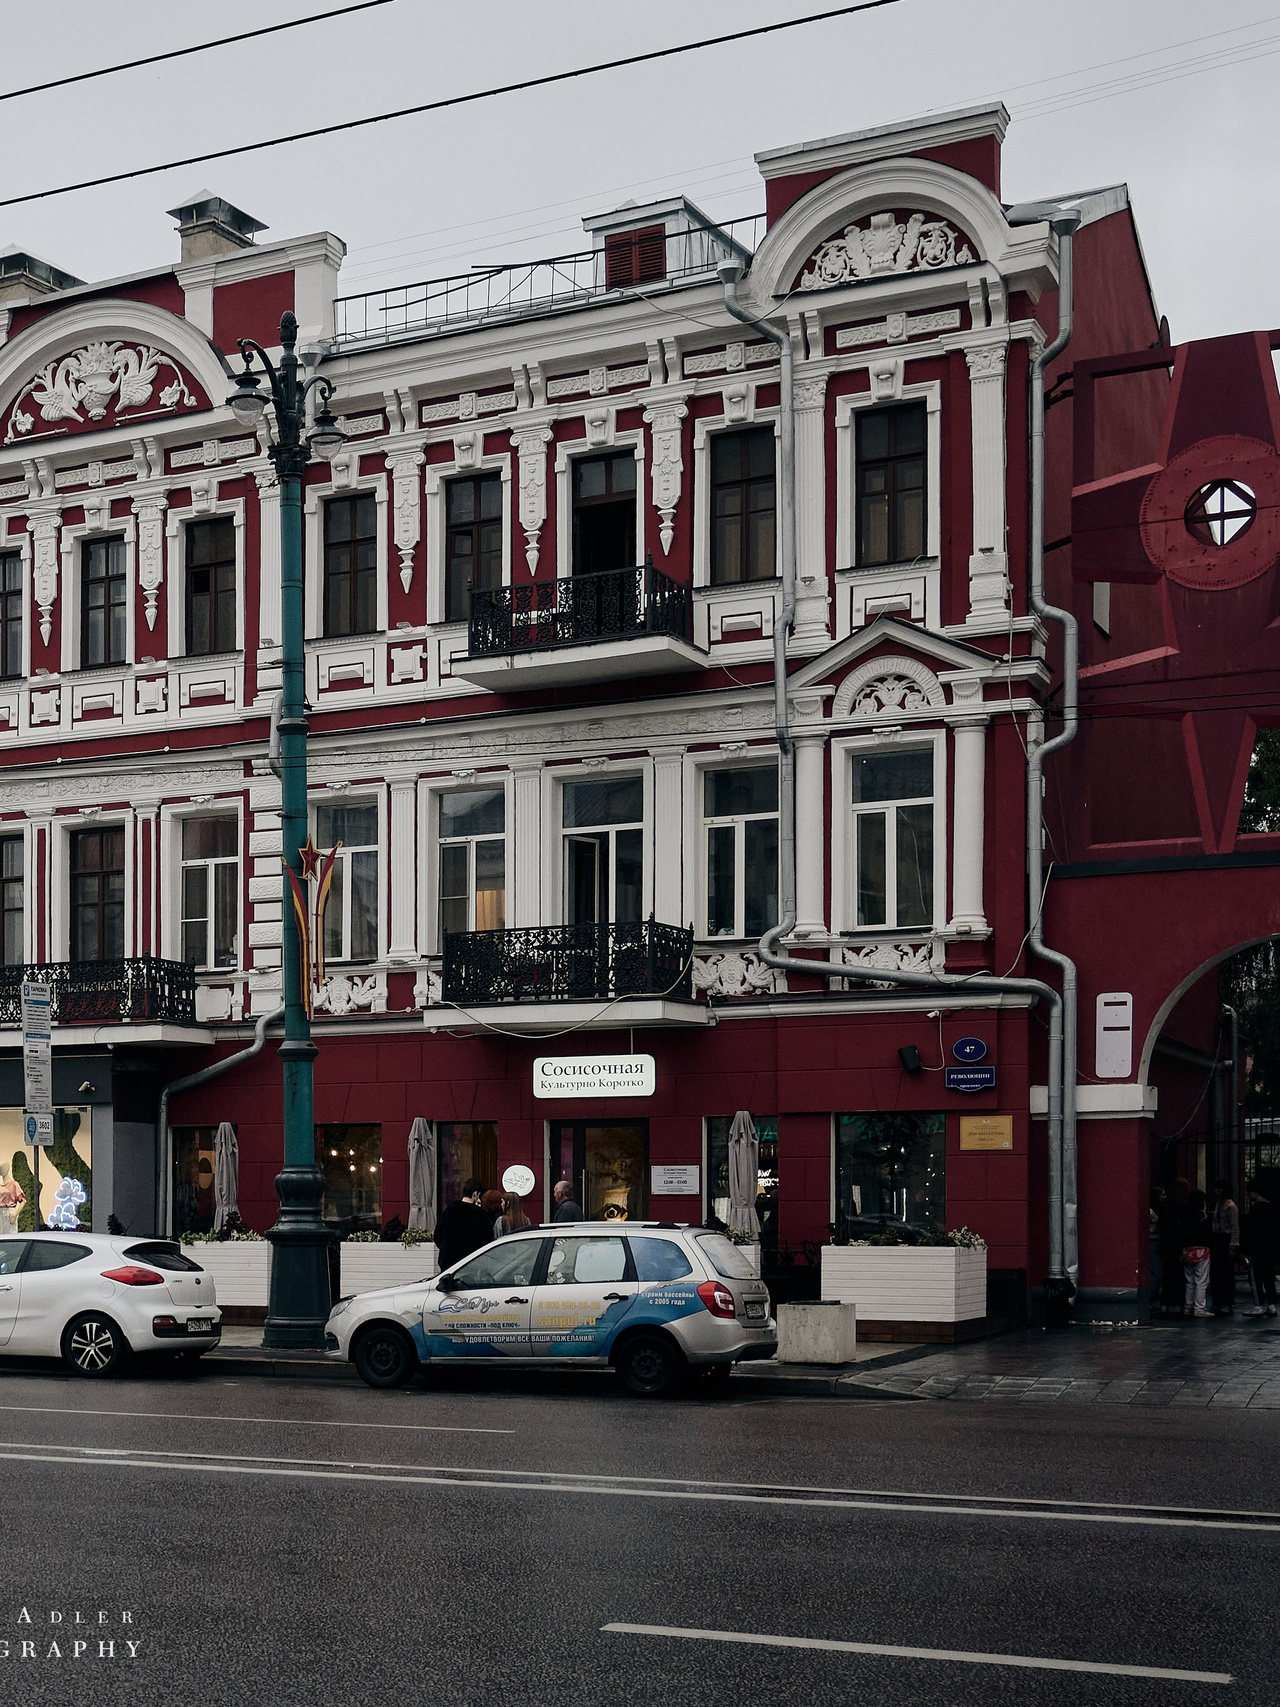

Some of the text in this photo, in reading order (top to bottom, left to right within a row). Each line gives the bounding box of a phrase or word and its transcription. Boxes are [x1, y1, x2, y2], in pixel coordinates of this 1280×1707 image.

[964, 1045, 975, 1053] 47
[541, 1061, 644, 1076] Сосисочная
[540, 1079, 644, 1091] Культурно Коротко
[537, 1314, 597, 1328] sanpul.ru
[552, 1334, 595, 1342] ПОЖЕЛАНИЯ!
